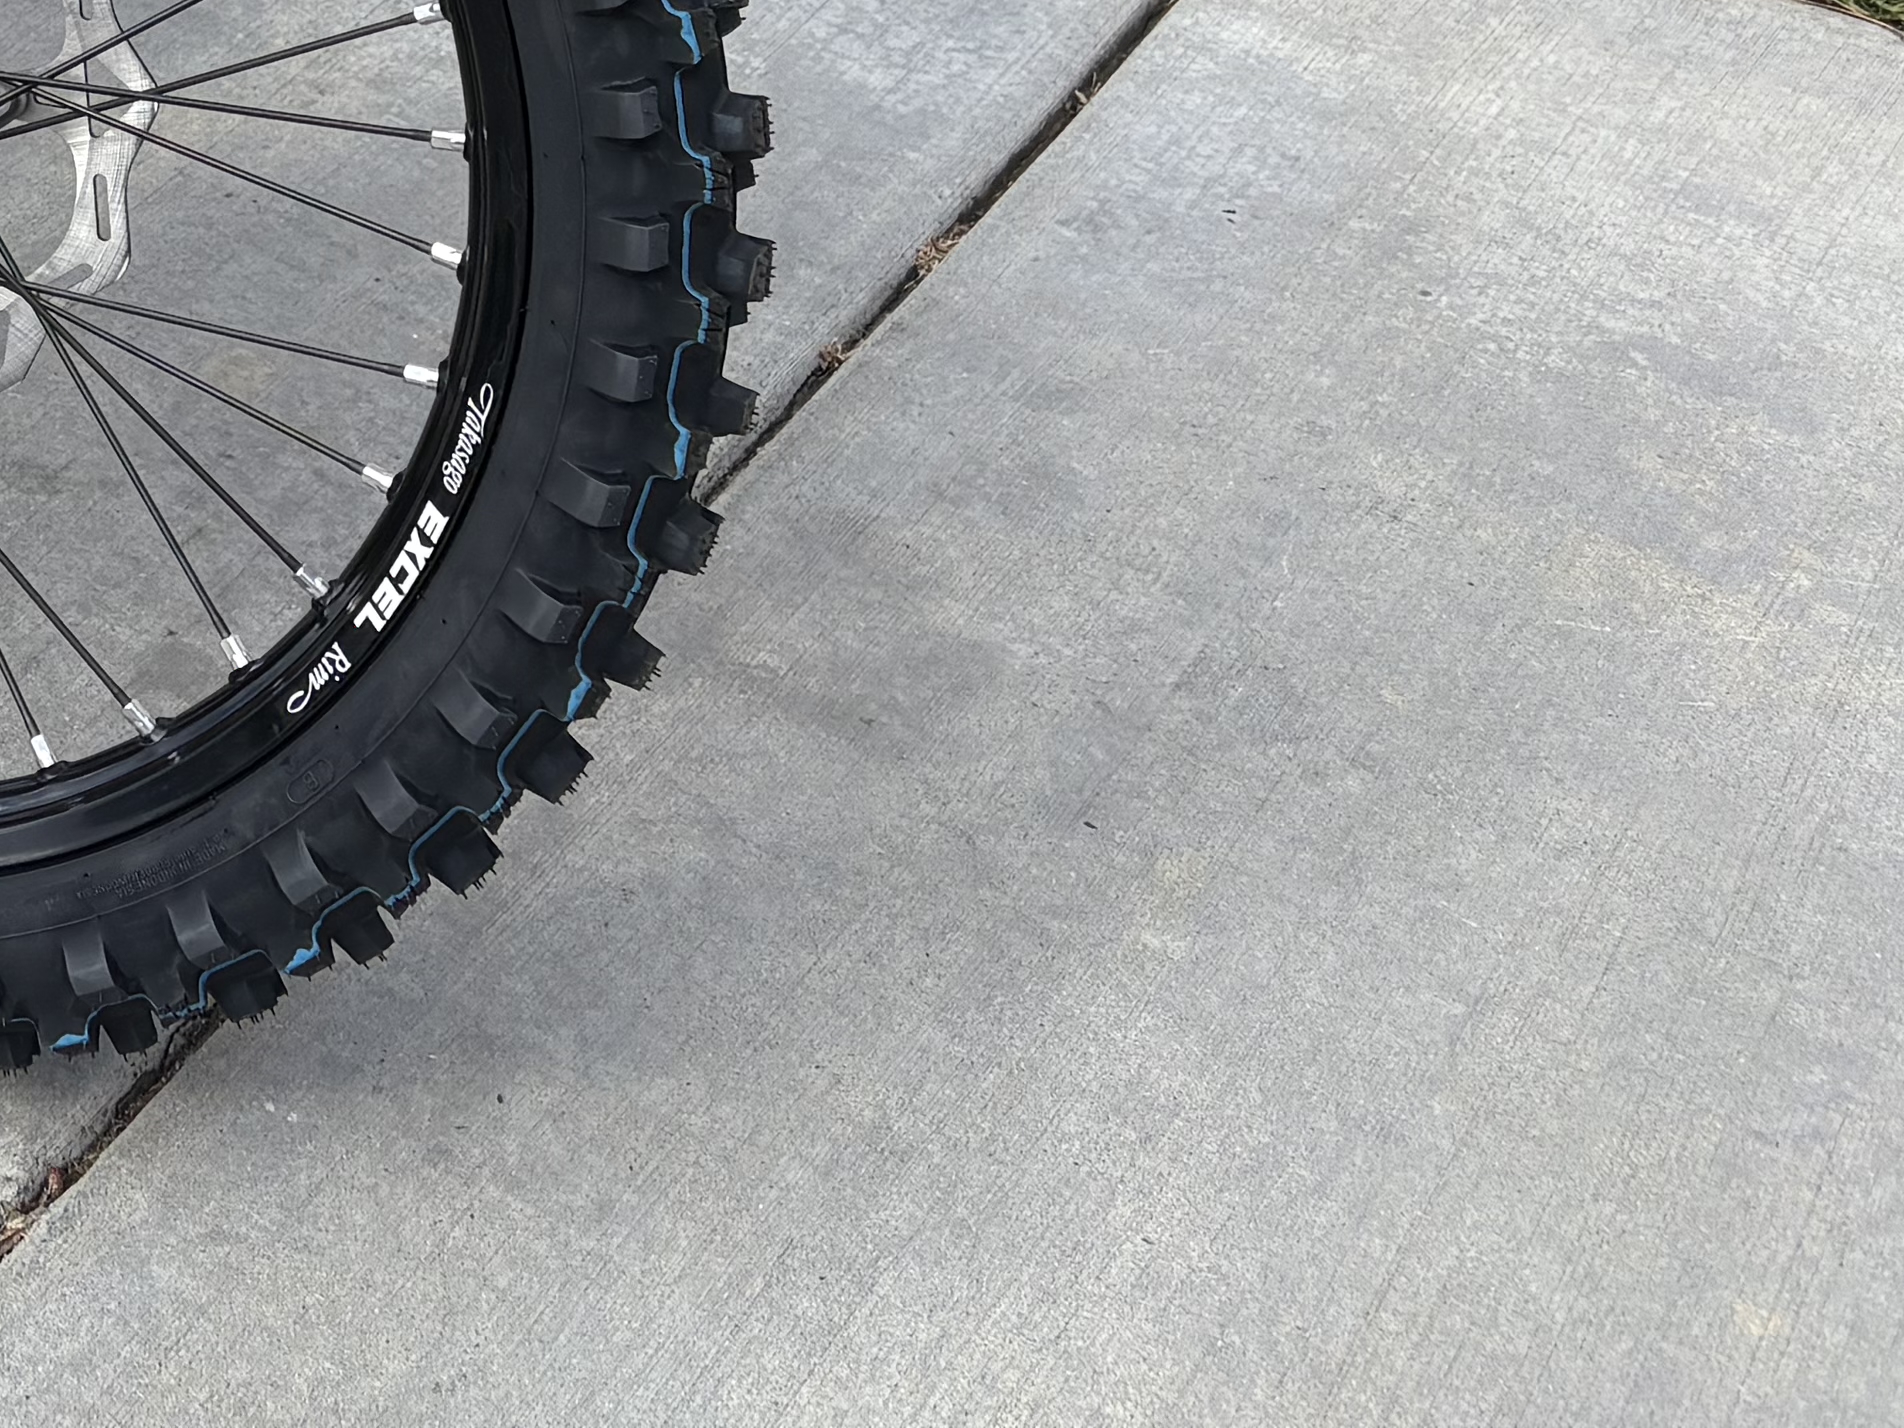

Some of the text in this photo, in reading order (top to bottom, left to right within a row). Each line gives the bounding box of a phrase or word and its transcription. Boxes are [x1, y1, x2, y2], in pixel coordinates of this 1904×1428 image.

[286, 382, 494, 714] Takasago EXCEL Rim
